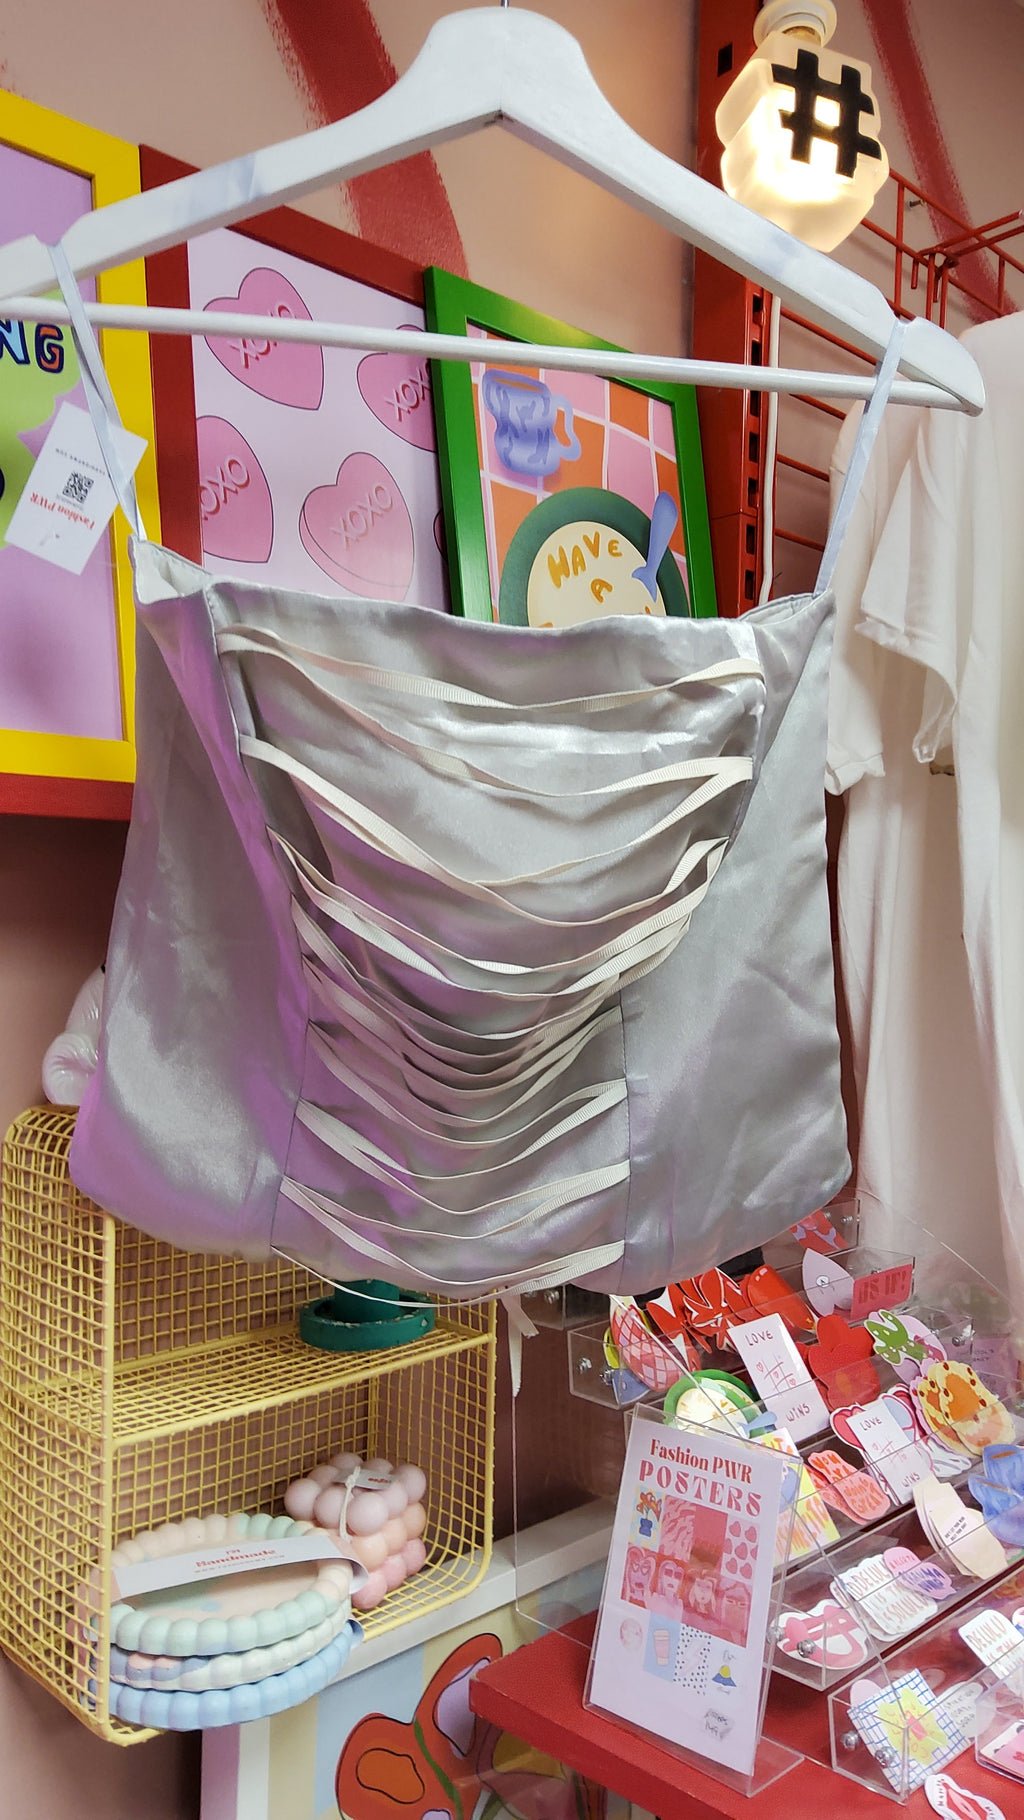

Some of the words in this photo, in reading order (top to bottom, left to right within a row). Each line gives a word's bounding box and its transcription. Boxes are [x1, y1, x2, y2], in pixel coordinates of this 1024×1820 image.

[384, 360, 431, 422] XOX
[200, 454, 250, 520] OXO
[330, 482, 393, 552] XOXO
[547, 530, 623, 588] HAVE
[590, 578, 613, 603] A
[745, 1330, 774, 1347] LOVE
[785, 1402, 811, 1423] WINS
[859, 1416, 882, 1432] LOVE
[649, 1437, 710, 1473] Fashion
[711, 1455, 753, 1485] PWR
[638, 1459, 762, 1518] POSTERS
